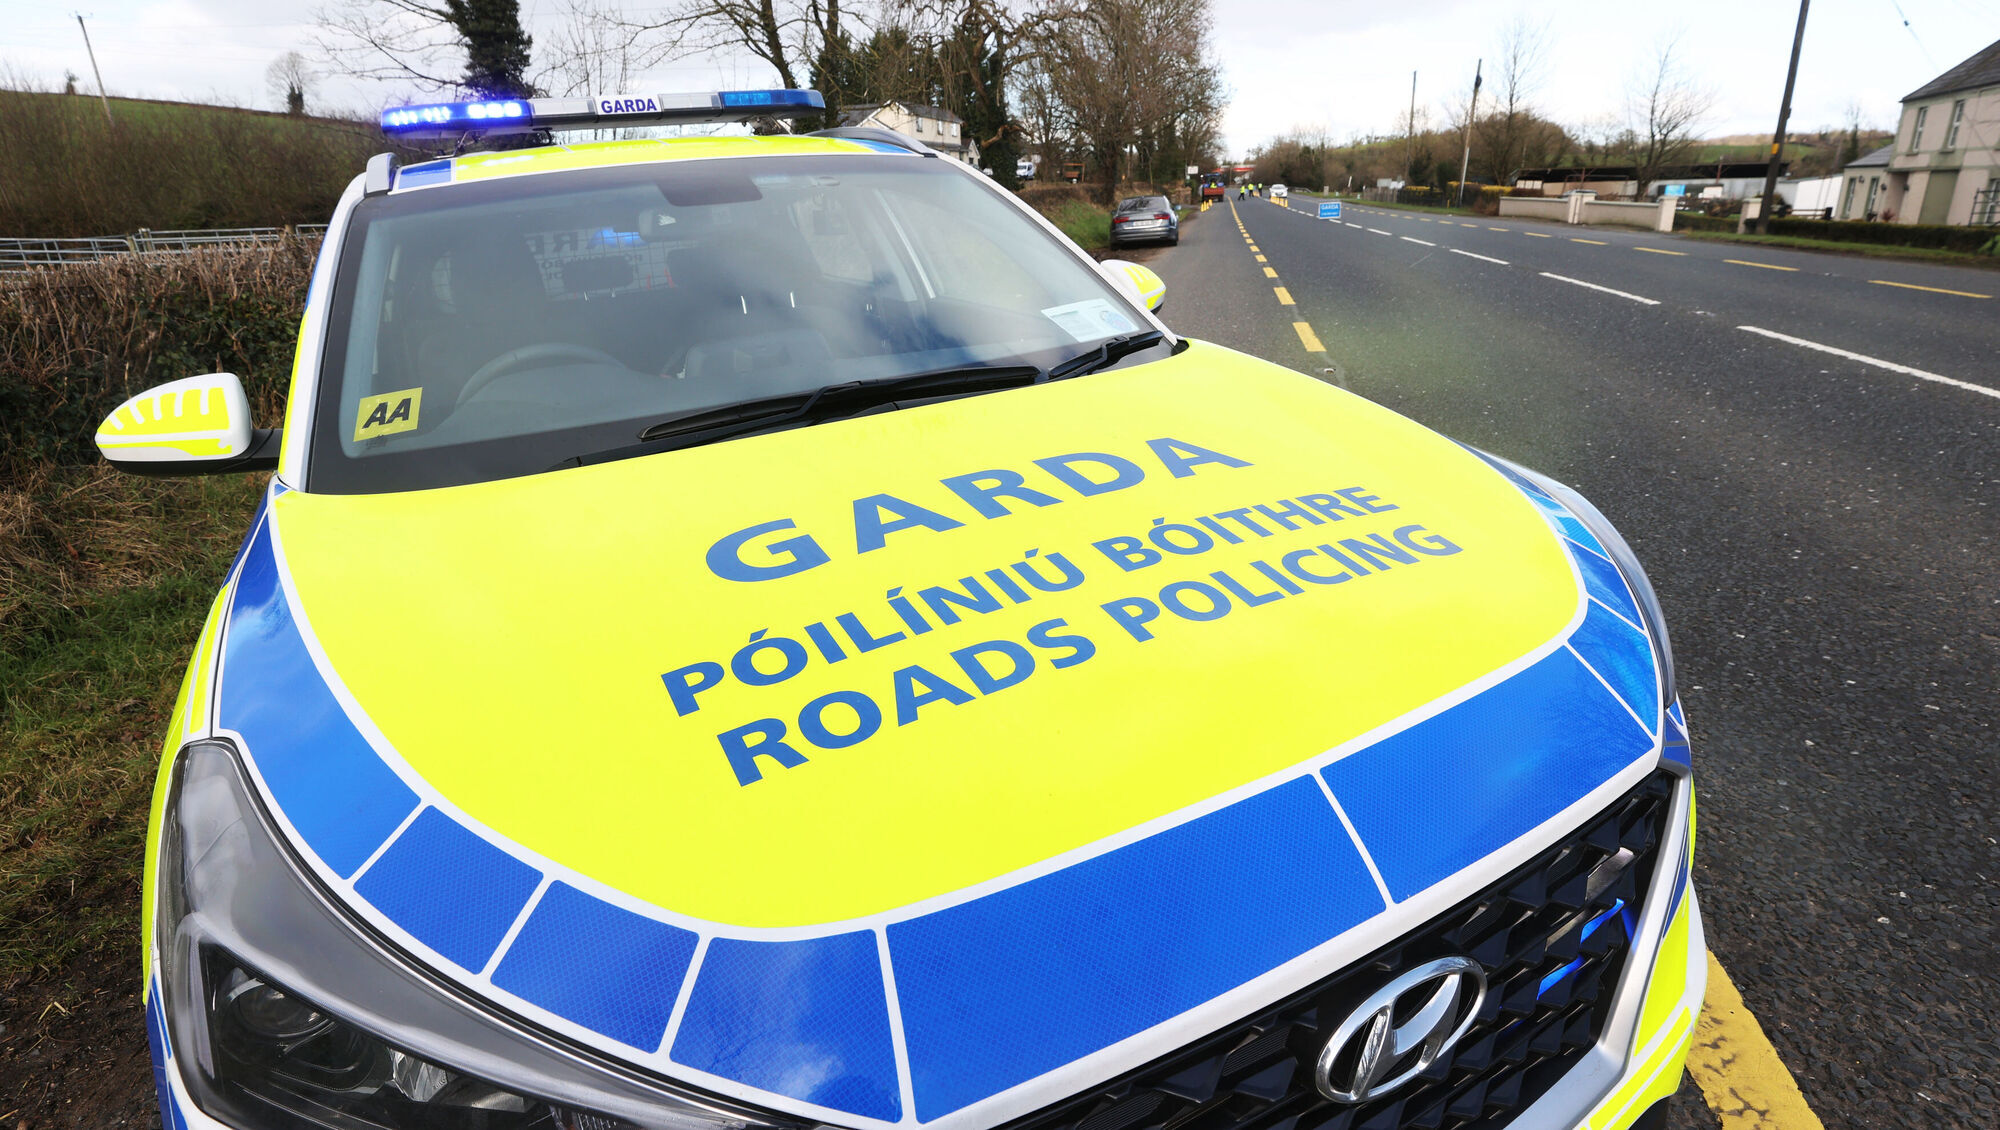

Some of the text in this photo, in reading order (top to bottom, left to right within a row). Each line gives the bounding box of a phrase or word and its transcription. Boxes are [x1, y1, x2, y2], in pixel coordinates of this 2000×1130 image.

[601, 98, 657, 113] GARDA
[362, 397, 412, 429] AA
[706, 437, 1254, 583] GARDA
[661, 486, 1400, 717] PÓILÍNIÚ BÓITHRE
[717, 524, 1464, 787] ROADS POLICING
